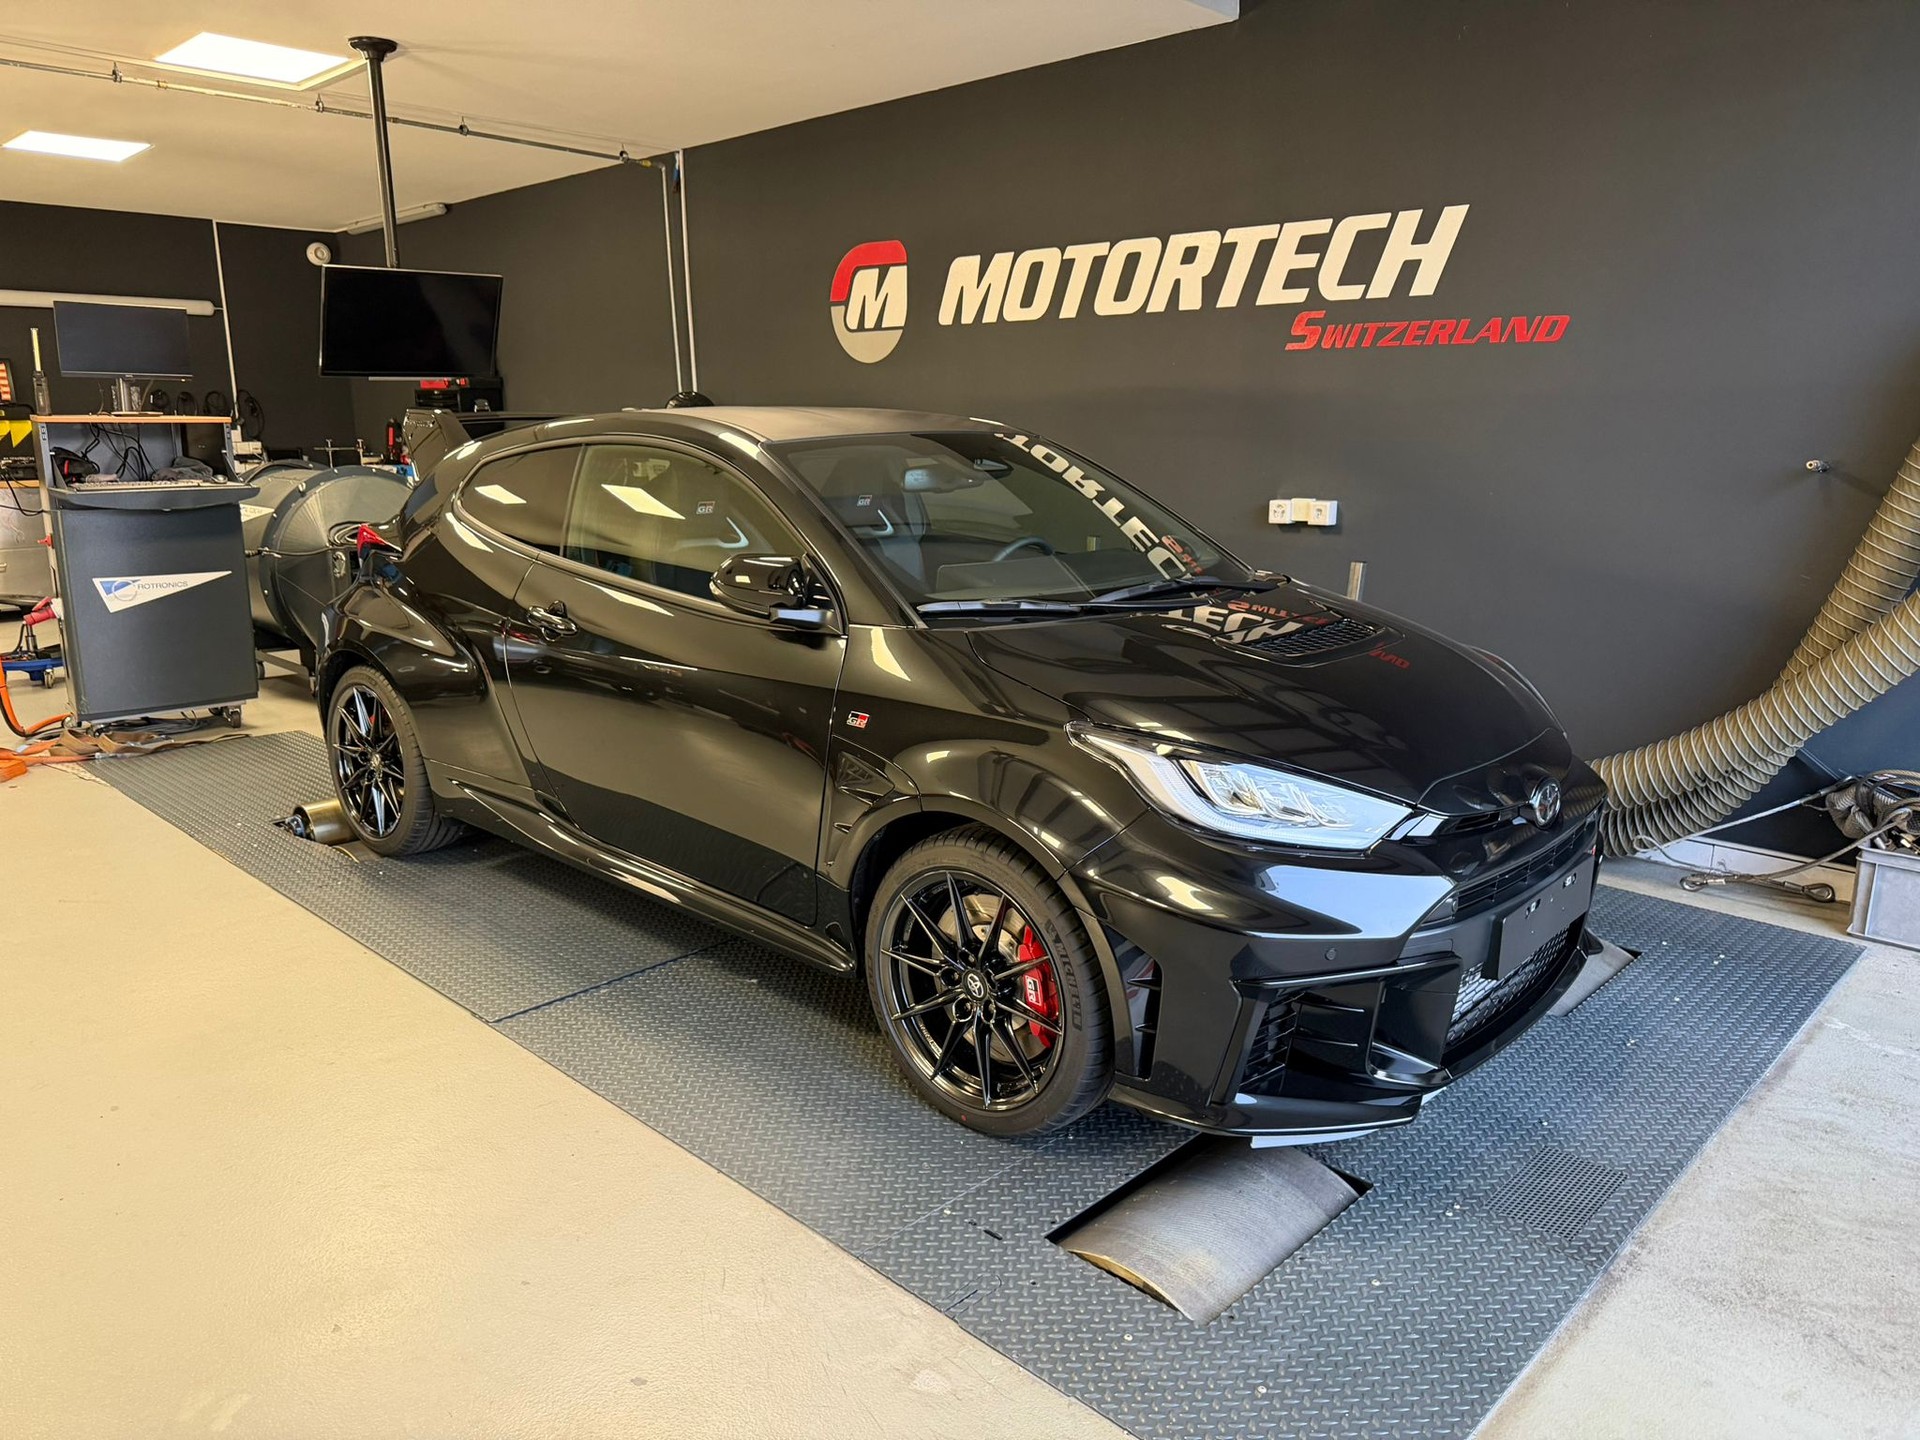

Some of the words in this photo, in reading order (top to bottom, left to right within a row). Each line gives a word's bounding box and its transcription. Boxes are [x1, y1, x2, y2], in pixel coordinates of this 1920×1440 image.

[938, 204, 1470, 326] MOTORTECH
[846, 266, 907, 330] M
[1285, 311, 1570, 350] SWITZERLAND
[697, 502, 714, 514] GR
[847, 713, 868, 728] GR
[1025, 976, 1039, 1005] GR
